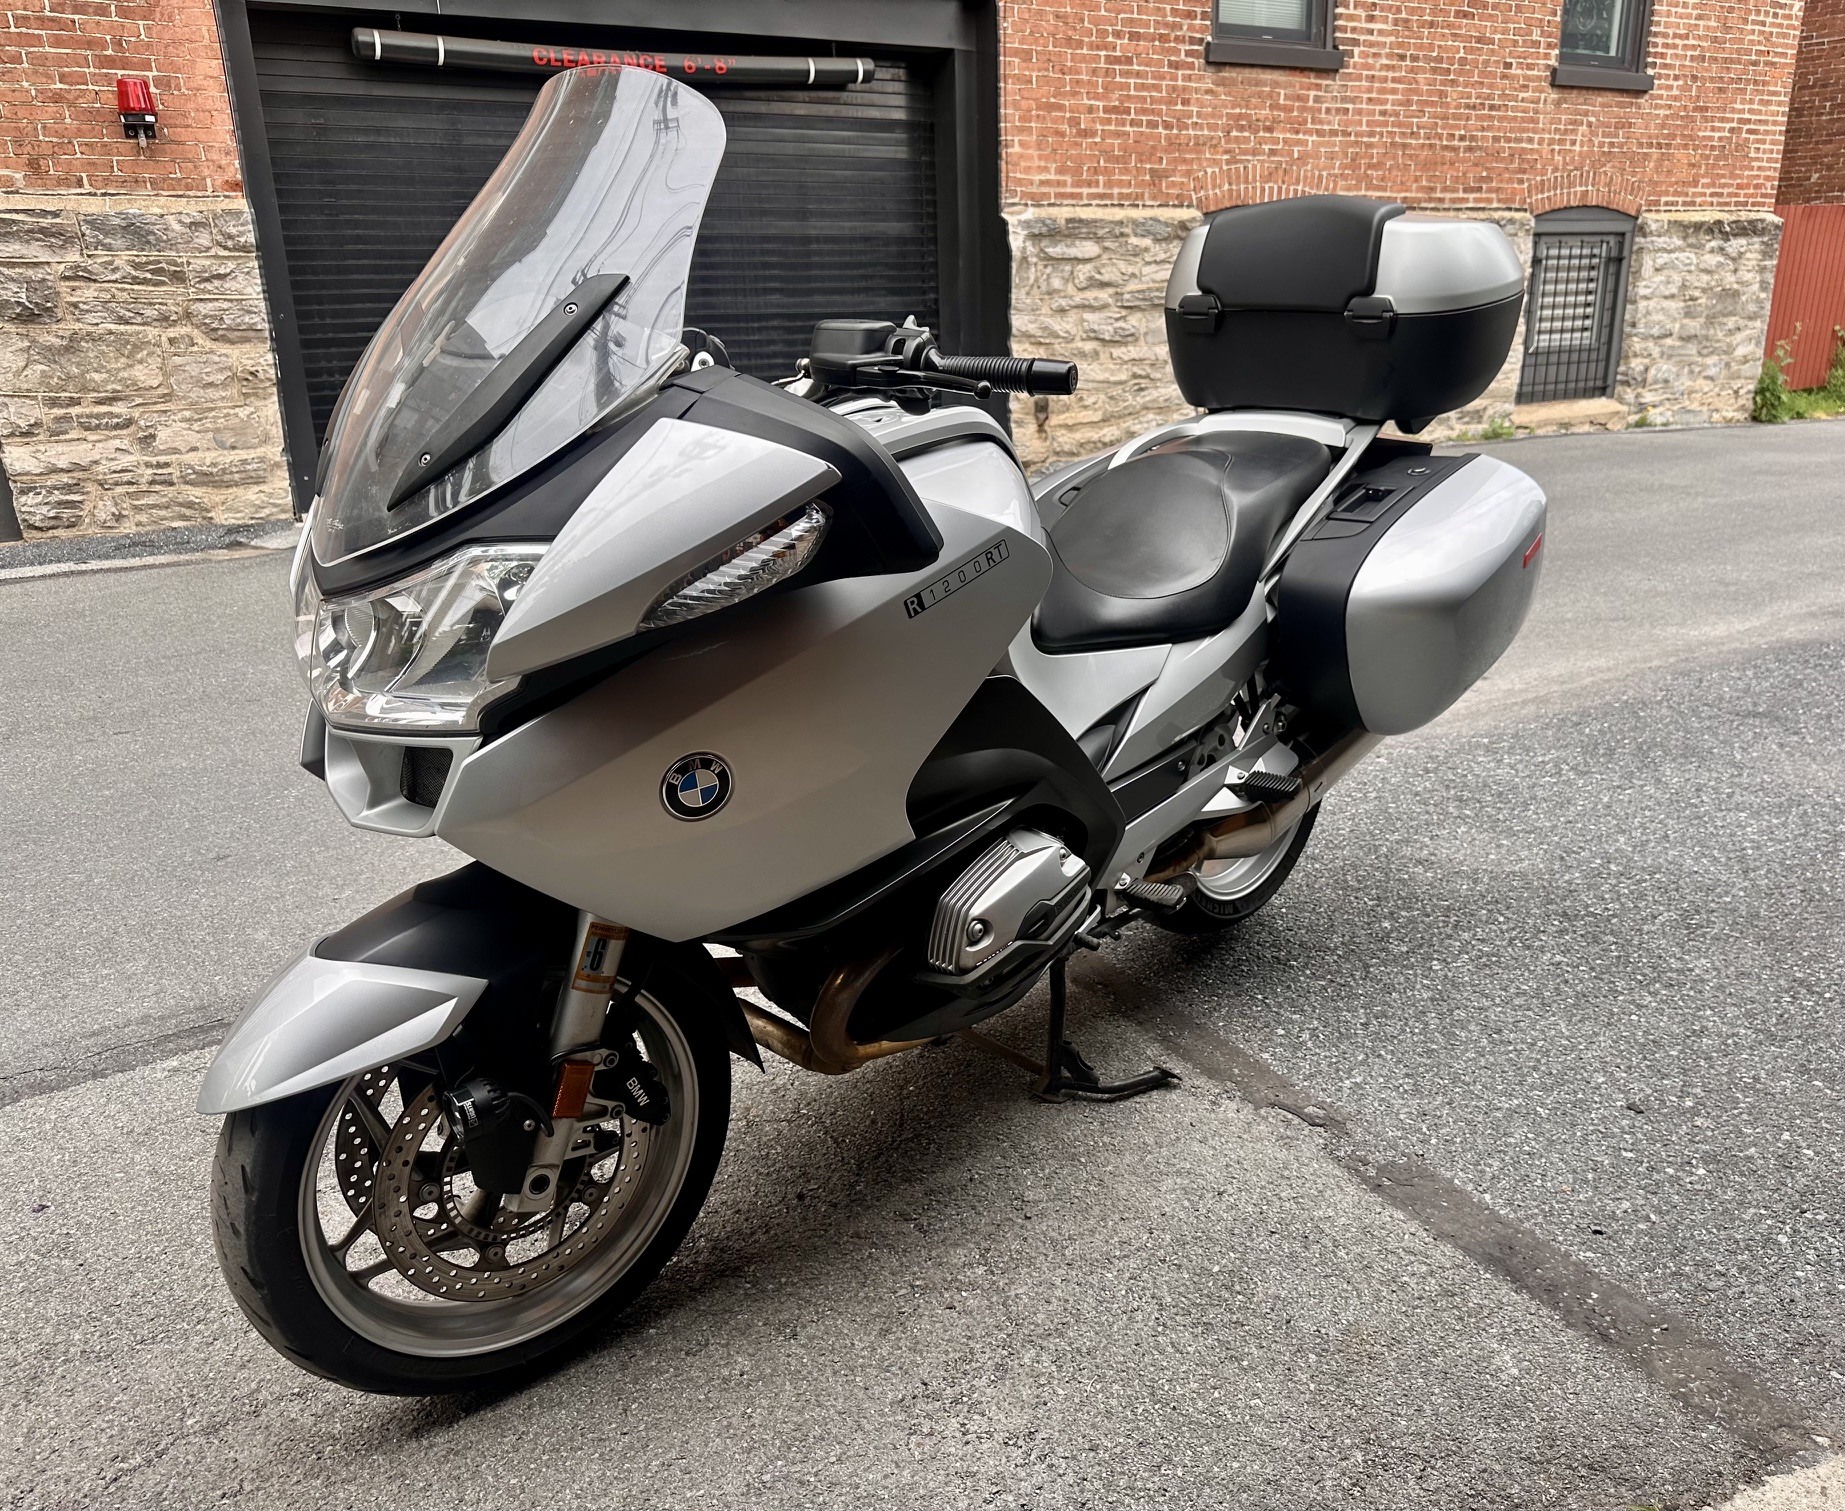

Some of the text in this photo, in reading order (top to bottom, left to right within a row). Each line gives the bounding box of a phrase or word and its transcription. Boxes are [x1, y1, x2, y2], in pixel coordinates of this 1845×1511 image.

[532, 47, 668, 73] CLEARANCE
[668, 758, 723, 785] BMW
[626, 1077, 650, 1107] BMW
